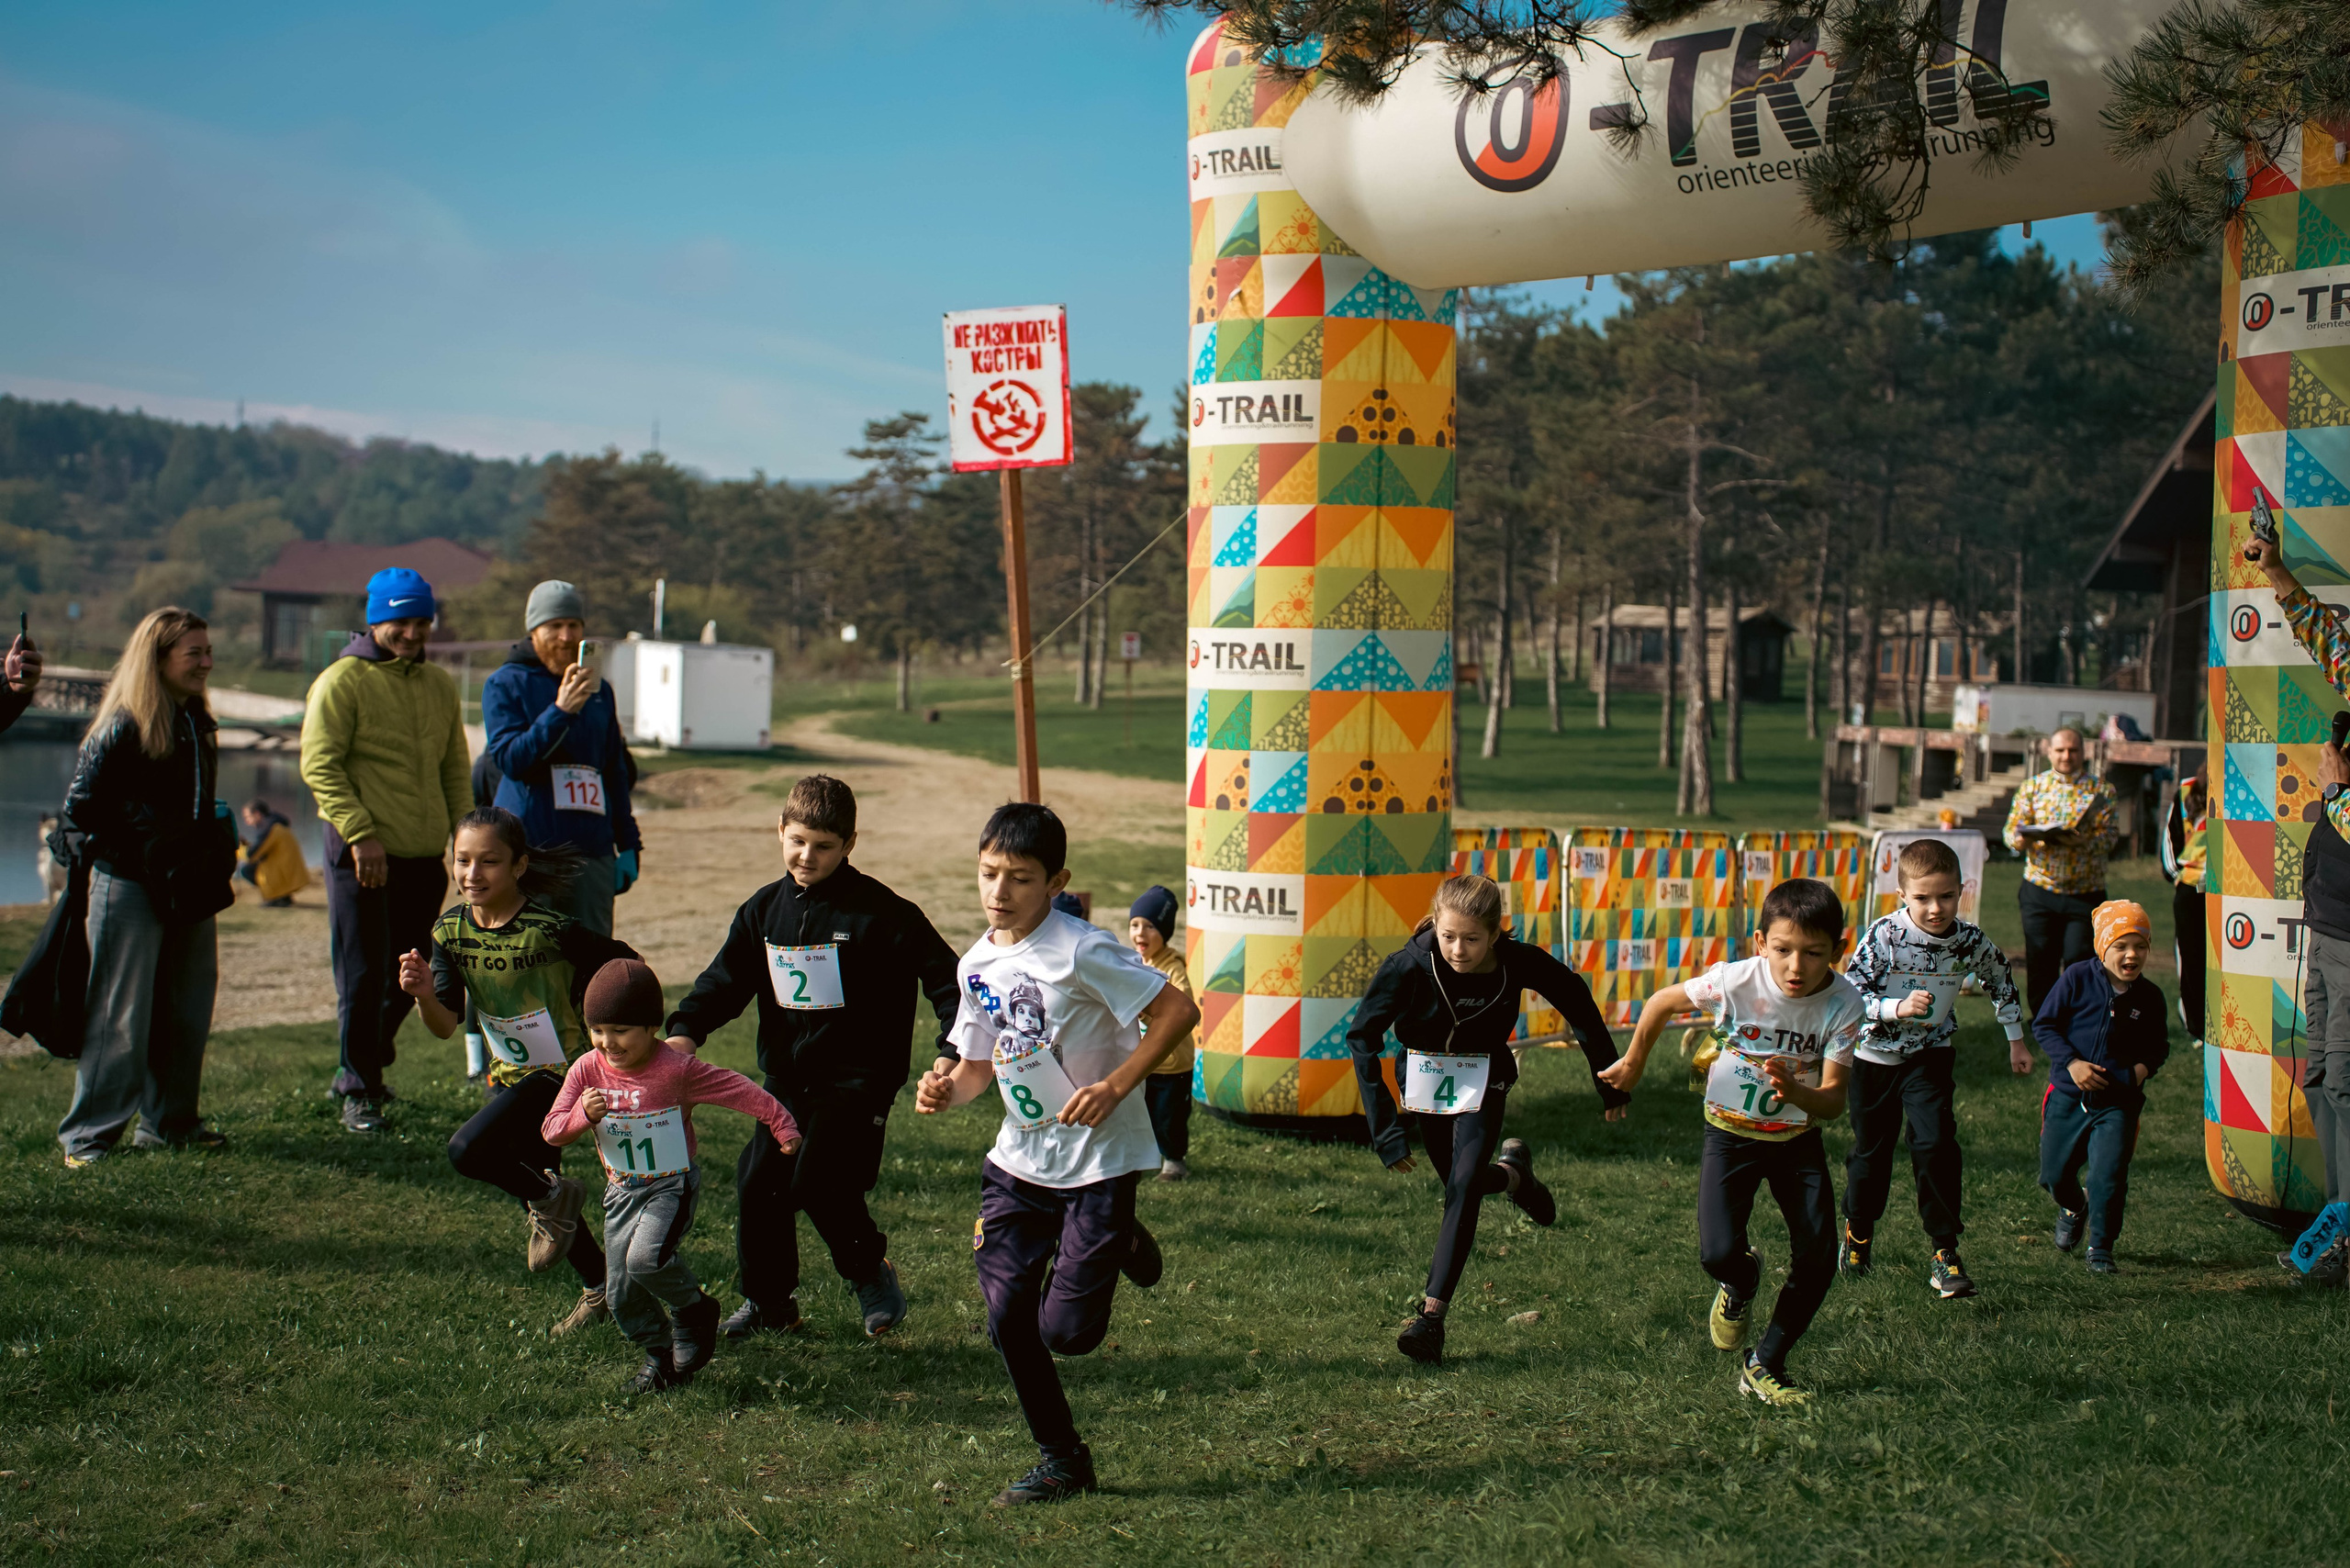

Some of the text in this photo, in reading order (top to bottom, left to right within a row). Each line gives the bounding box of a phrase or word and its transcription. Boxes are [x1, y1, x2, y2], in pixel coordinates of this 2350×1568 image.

[955, 319, 1057, 348] НЕ РАЗЖИГАТЬ
[971, 345, 1042, 374] КОСТРЫ
[565, 781, 599, 806] 112
[484, 957, 507, 971] GO
[789, 970, 811, 1002] 2
[1455, 998, 1485, 1007] FILA
[504, 1037, 529, 1063] 9
[1010, 1084, 1044, 1119] 8
[1433, 1076, 1458, 1107] 4
[1740, 1082, 1785, 1116] 10
[617, 1137, 655, 1170] 11
